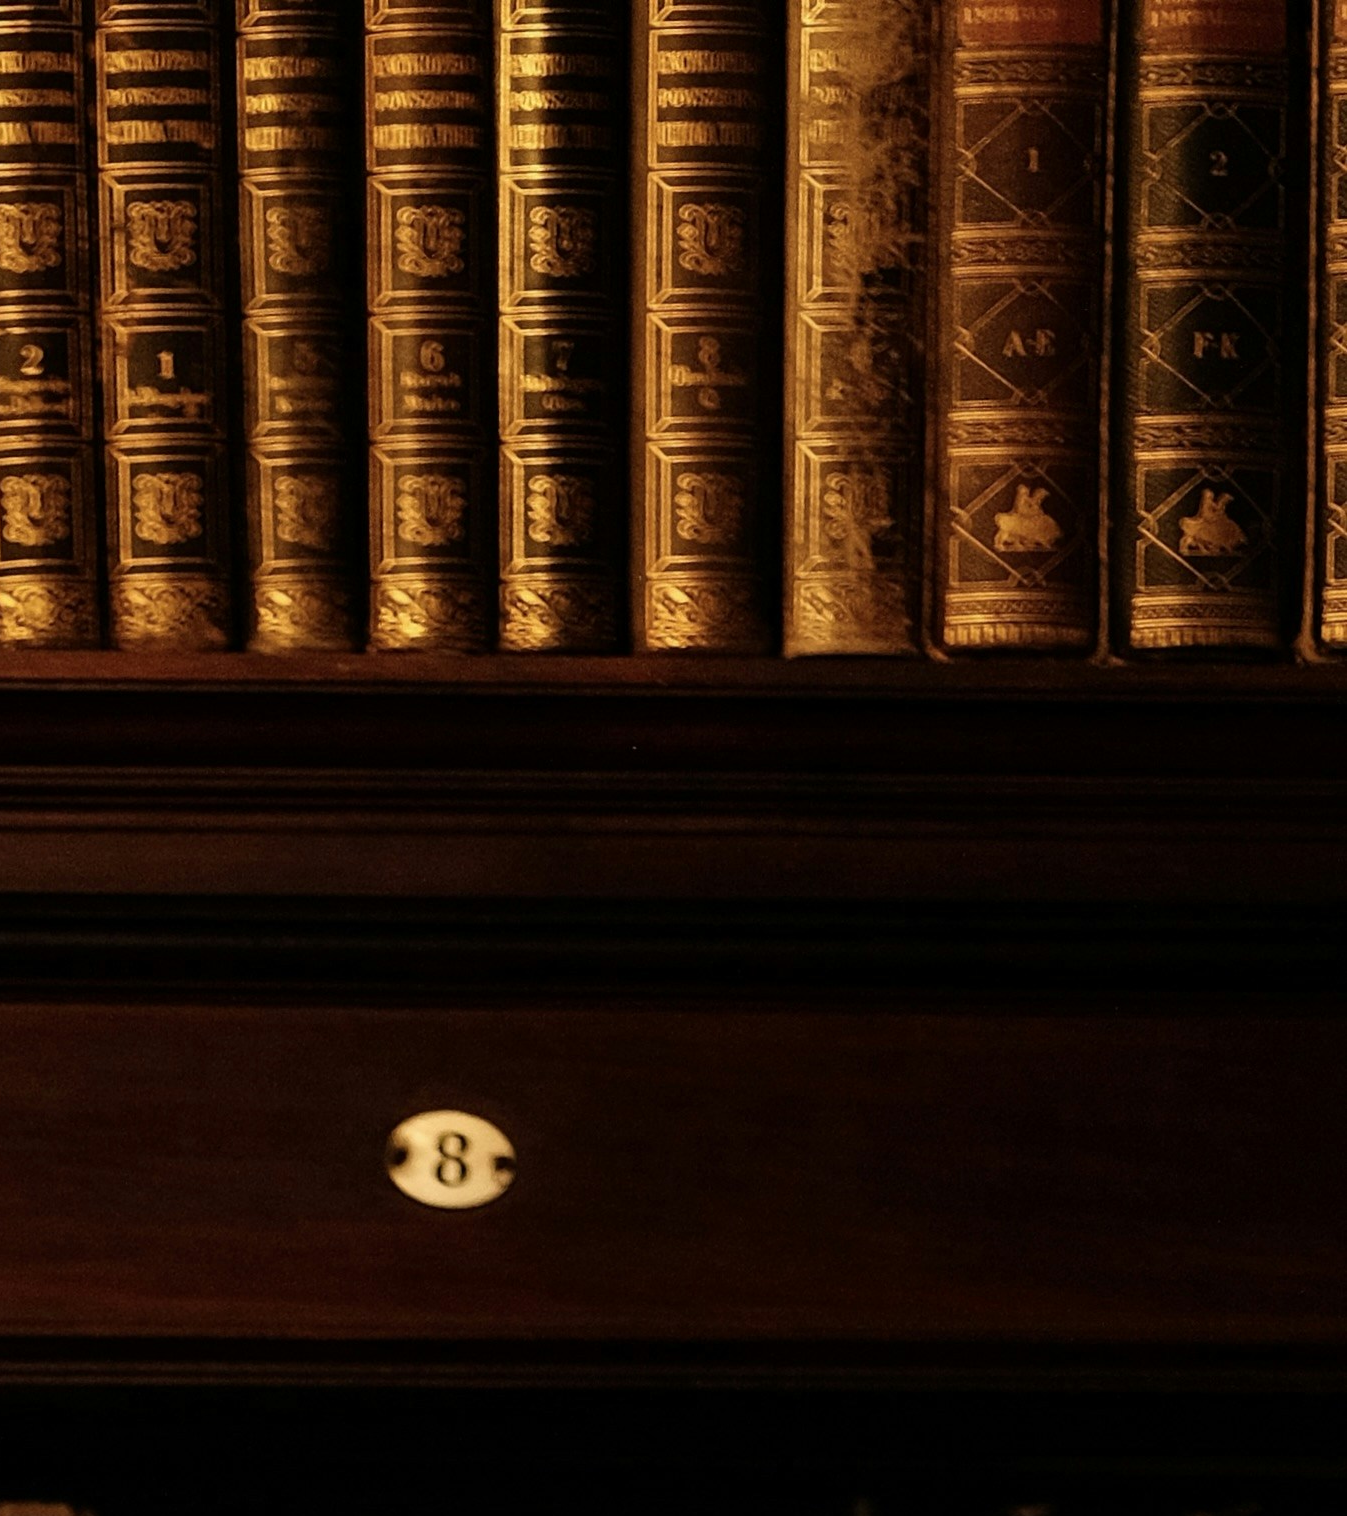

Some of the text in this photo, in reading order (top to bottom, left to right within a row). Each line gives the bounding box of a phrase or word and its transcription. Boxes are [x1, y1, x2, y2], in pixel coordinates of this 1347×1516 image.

[1209, 150, 1230, 177] 2
[19, 343, 46, 376] 2
[156, 349, 176, 380] 1
[419, 340, 447, 373] 6
[437, 1132, 468, 1187] 8
